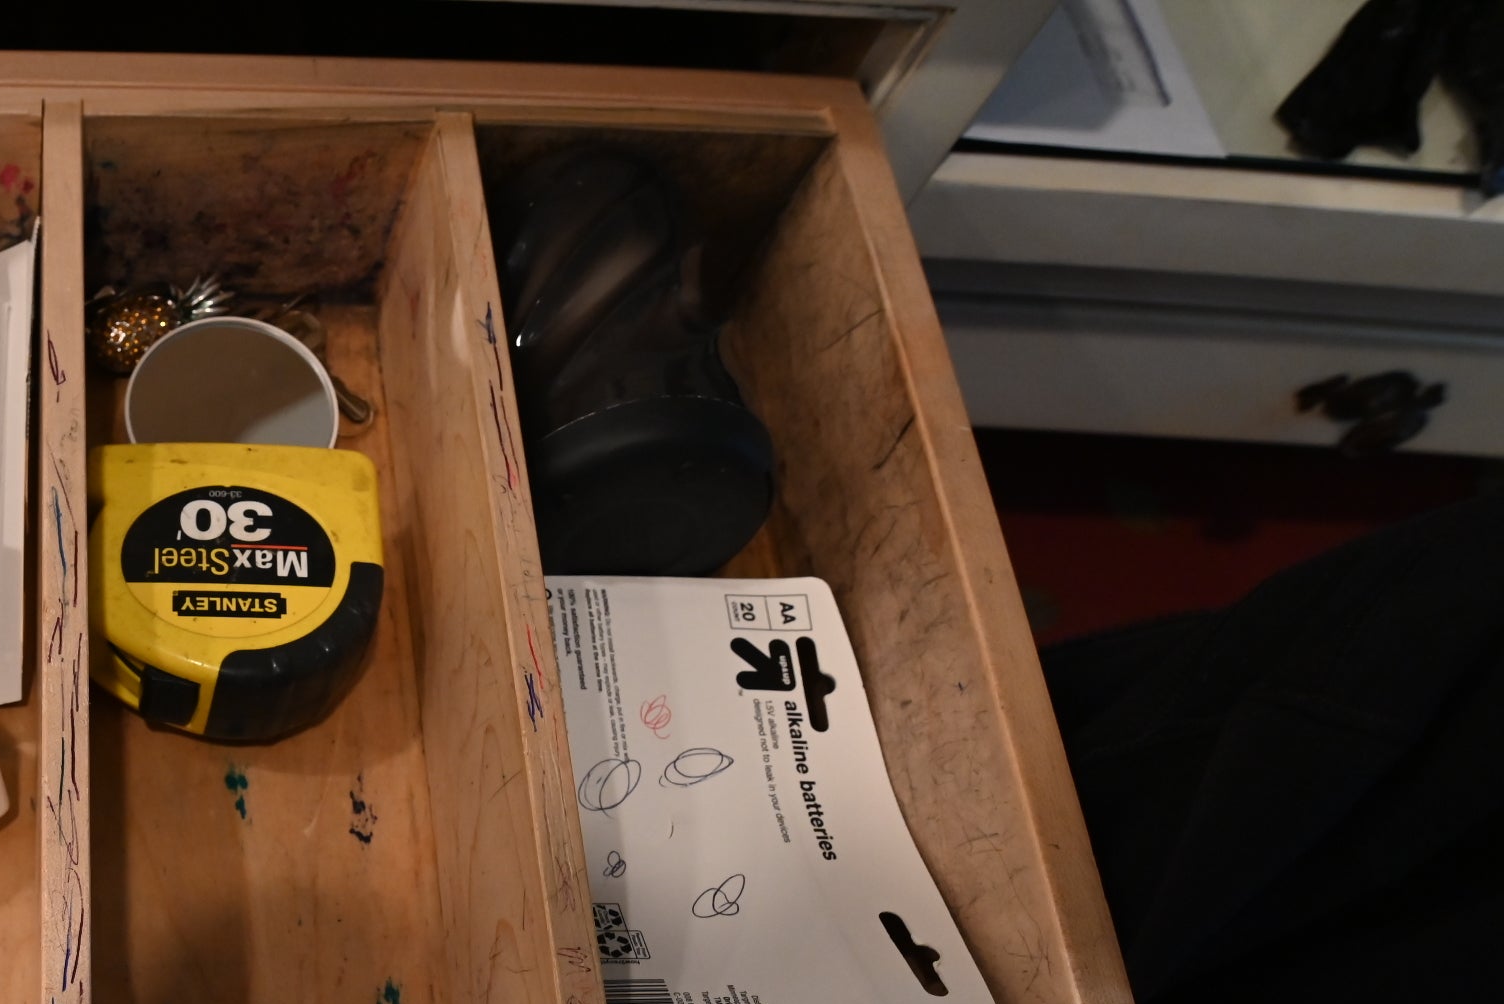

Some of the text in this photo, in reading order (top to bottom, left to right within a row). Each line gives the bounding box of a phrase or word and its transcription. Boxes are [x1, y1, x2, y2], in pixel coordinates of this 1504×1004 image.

[208, 490, 243, 498] 33-600
[180, 596, 279, 613] STANLEY
[739, 602, 755, 622] 20
[779, 602, 796, 625] AA
[570, 608, 580, 647] satisfaction
[574, 649, 586, 689] guaranteed
[753, 698, 766, 736] designed
[768, 718, 778, 749] alkaline
[760, 738, 768, 751] not
[762, 753, 769, 762] to
[764, 764, 773, 781] leak
[784, 700, 838, 862] alkaline batteries
[768, 793, 780, 810] your
[775, 813, 790, 842] devices
